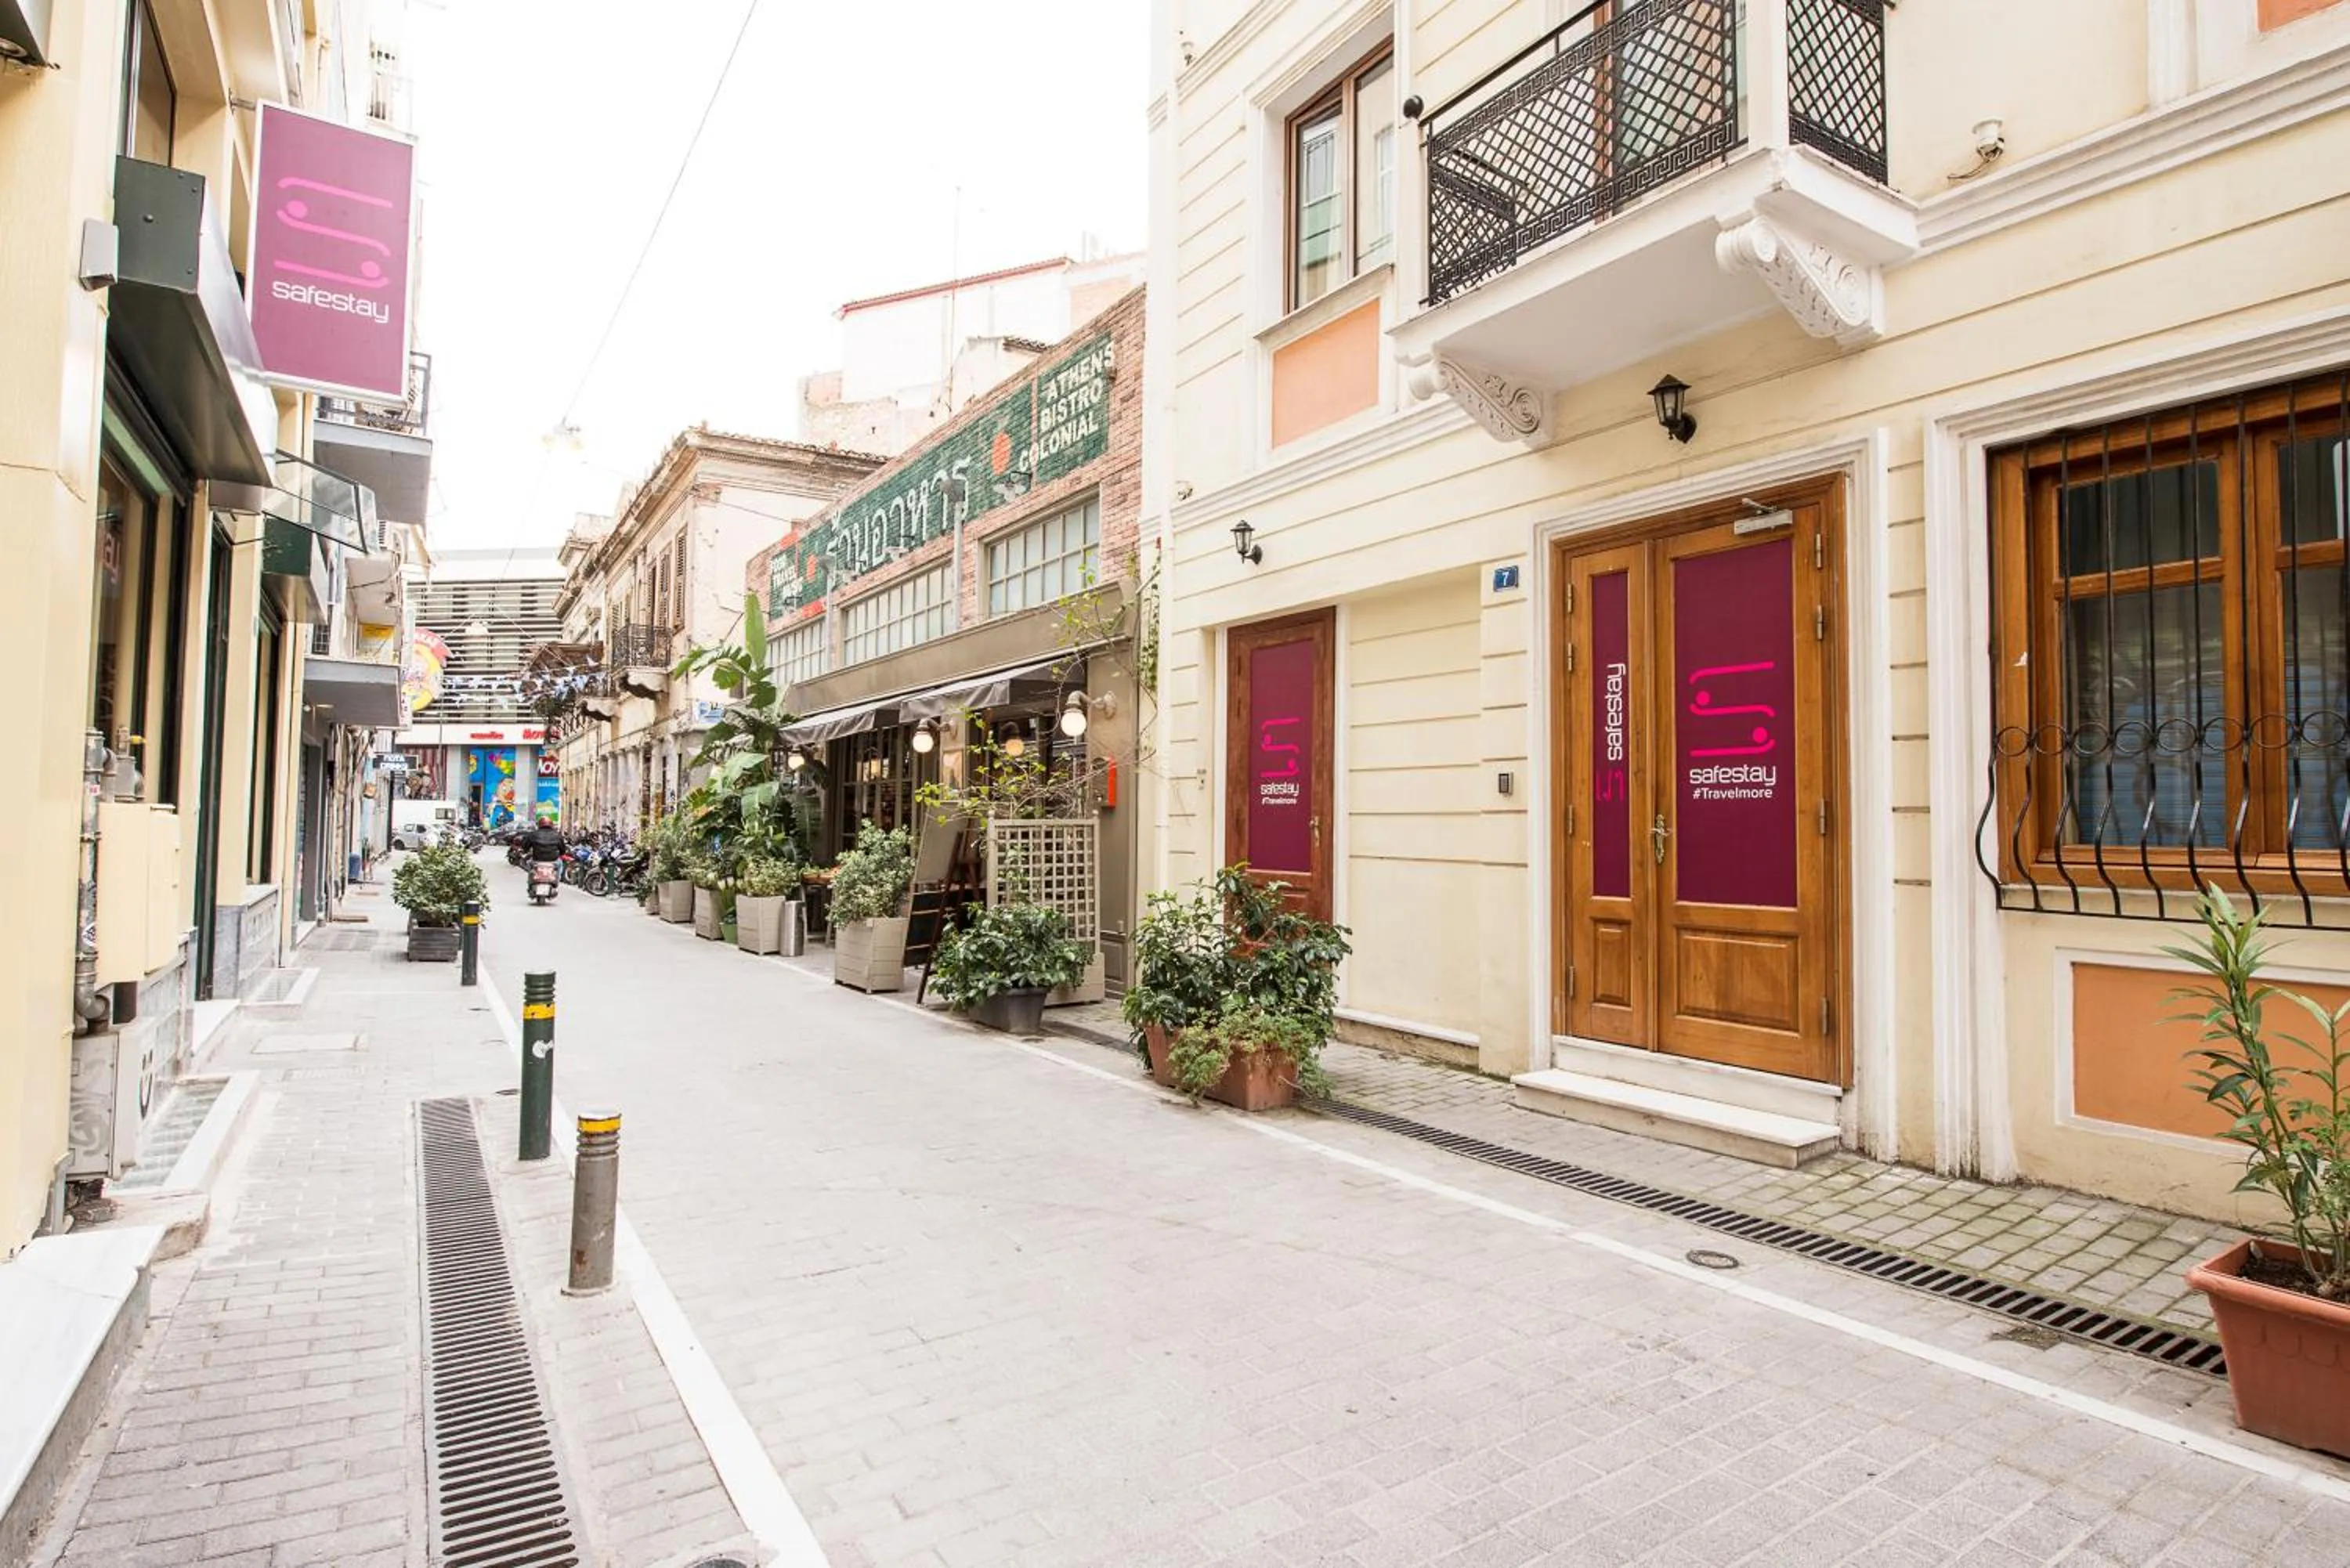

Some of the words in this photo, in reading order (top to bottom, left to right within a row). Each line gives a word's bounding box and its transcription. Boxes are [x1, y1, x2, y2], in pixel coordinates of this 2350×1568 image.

[272, 280, 389, 323] safestay
[1041, 341, 1115, 403] ATHENS
[1039, 378, 1103, 432] BISTRO
[1018, 410, 1098, 471] COLONIAL
[1502, 571, 1509, 587] 7
[1605, 663, 1626, 761] safestay
[1260, 782, 1300, 797] safestay
[1690, 764, 1777, 786] safestay
[1692, 786, 1773, 799] #Travelmore
